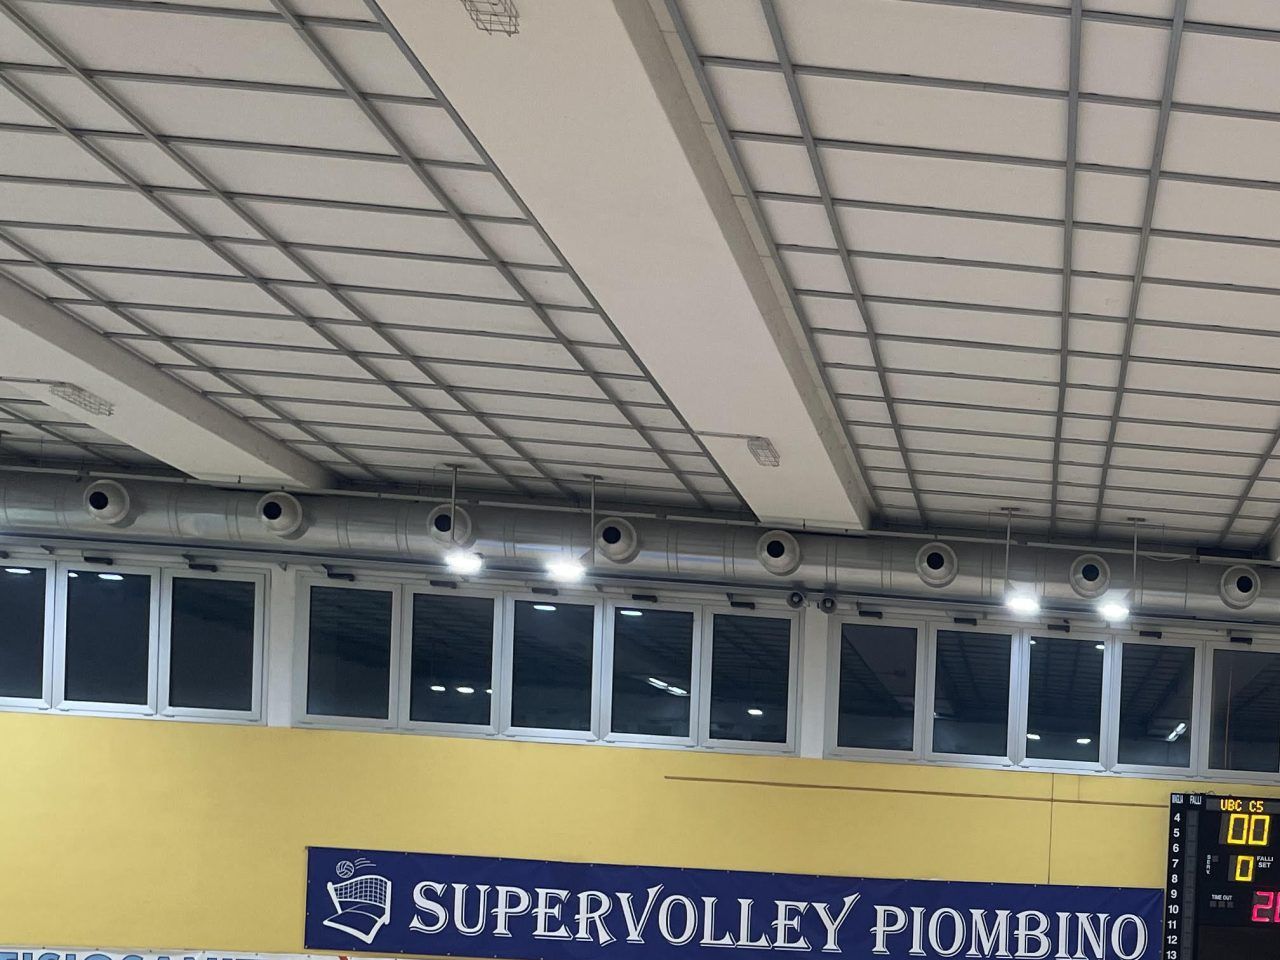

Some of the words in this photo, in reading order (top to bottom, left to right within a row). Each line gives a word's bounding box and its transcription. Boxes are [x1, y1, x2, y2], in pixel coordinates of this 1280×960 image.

[1220, 799, 1242, 811] UBC
[1249, 801, 1264, 812] C5
[1174, 813, 1181, 822] 4
[1173, 829, 1180, 837] 5
[1227, 813, 1270, 845] 00
[1172, 844, 1179, 853] 6
[1172, 859, 1179, 868] 7
[1235, 855, 1254, 881] 0
[1171, 874, 1178, 883] 8
[1171, 890, 1177, 898] 9
[1168, 905, 1178, 914] 10
[408, 880, 860, 952] SUPERVOLLEY
[1168, 920, 1177, 929] 11
[1167, 936, 1178, 944] 12
[1166, 951, 1177, 960] 13
